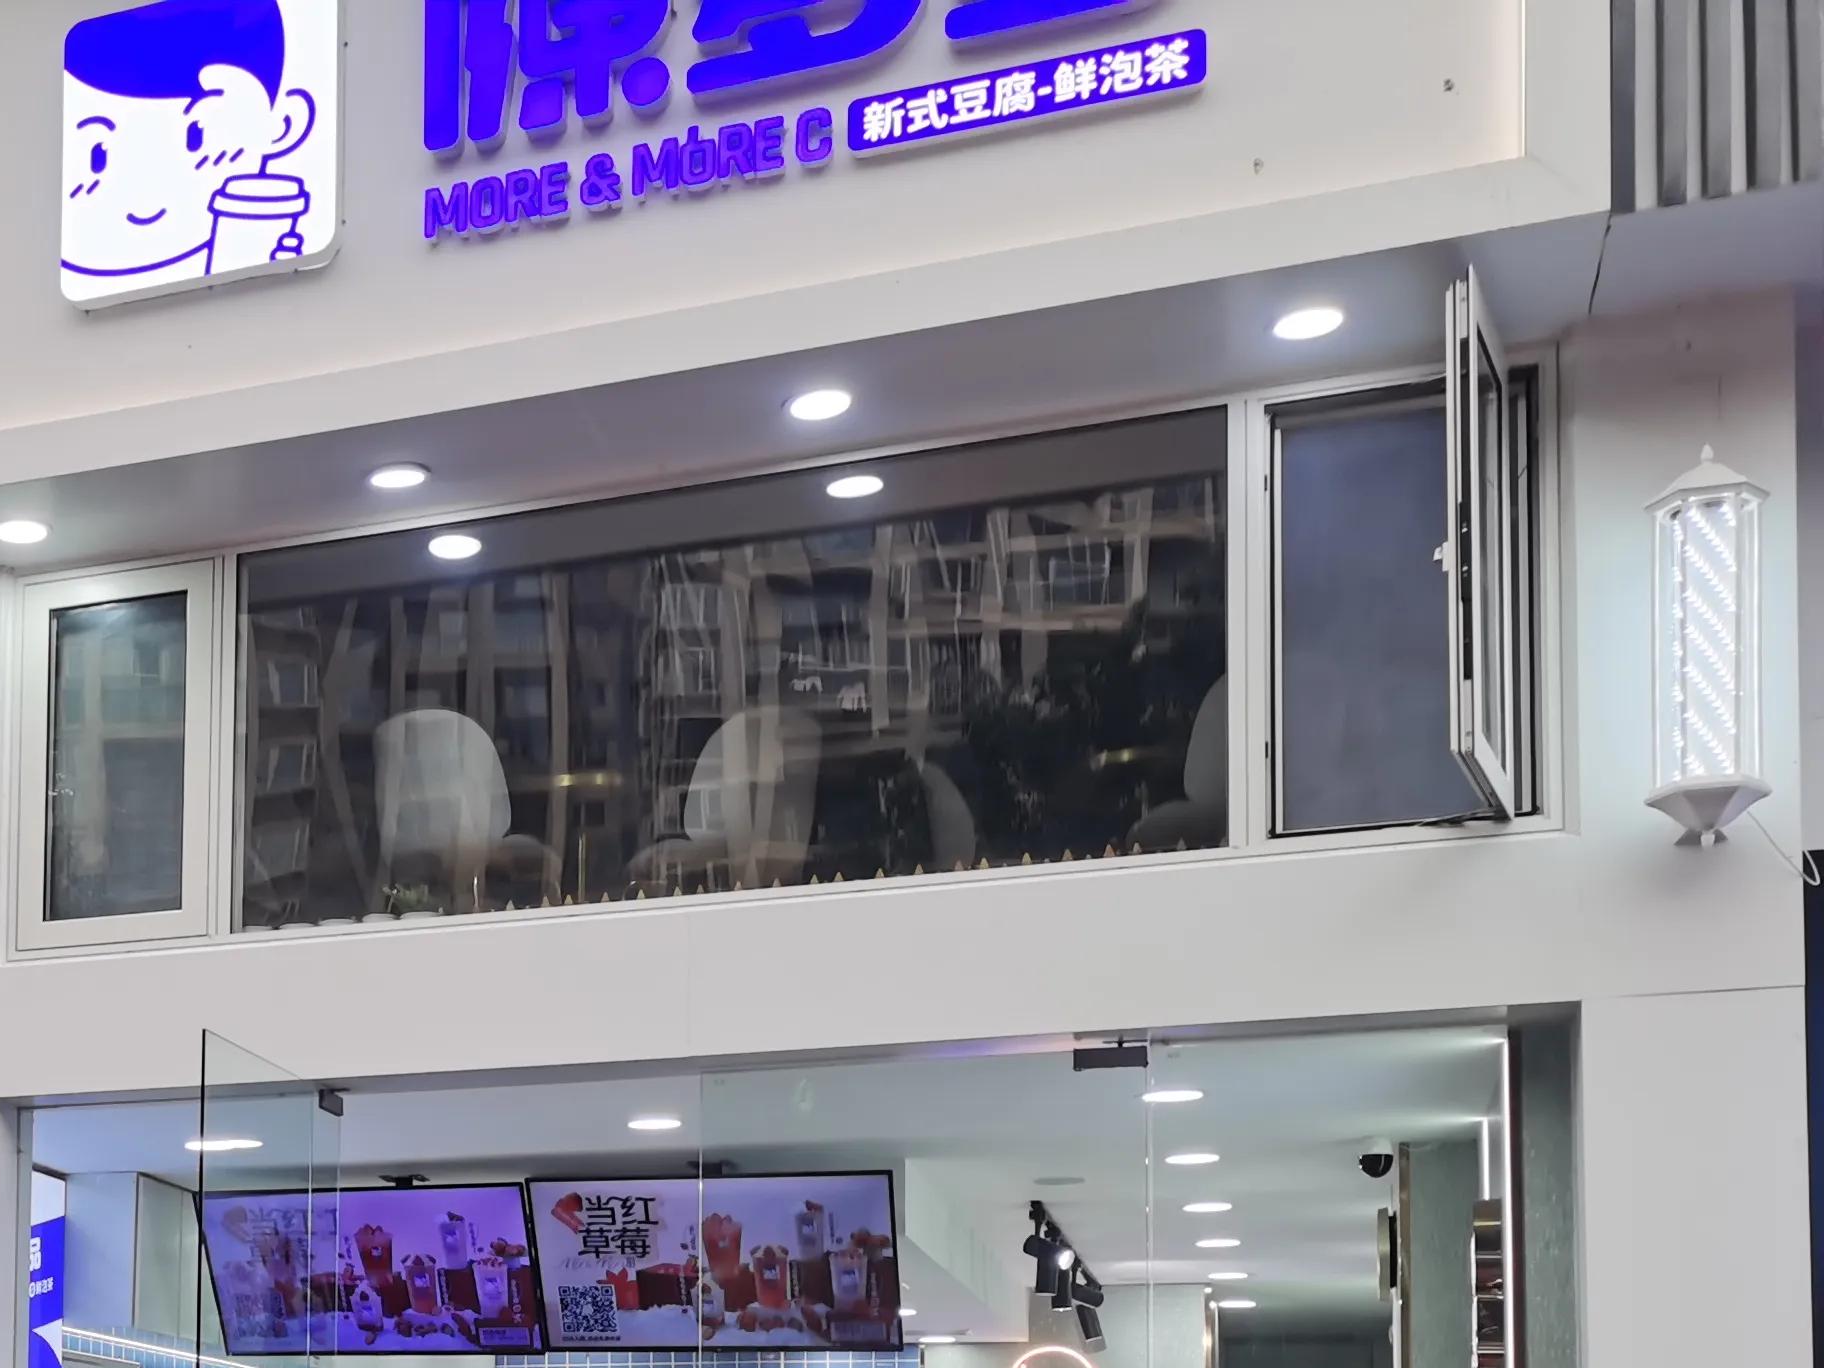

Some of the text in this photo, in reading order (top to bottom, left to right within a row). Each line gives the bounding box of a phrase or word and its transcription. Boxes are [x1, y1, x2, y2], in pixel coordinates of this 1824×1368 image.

[862, 40, 1190, 145] 新式豆腐-鲜泡茶
[424, 163, 569, 240] MORE
[580, 153, 622, 203] &
[584, 1194, 659, 1226] 当红
[577, 1228, 651, 1260] 草莓
